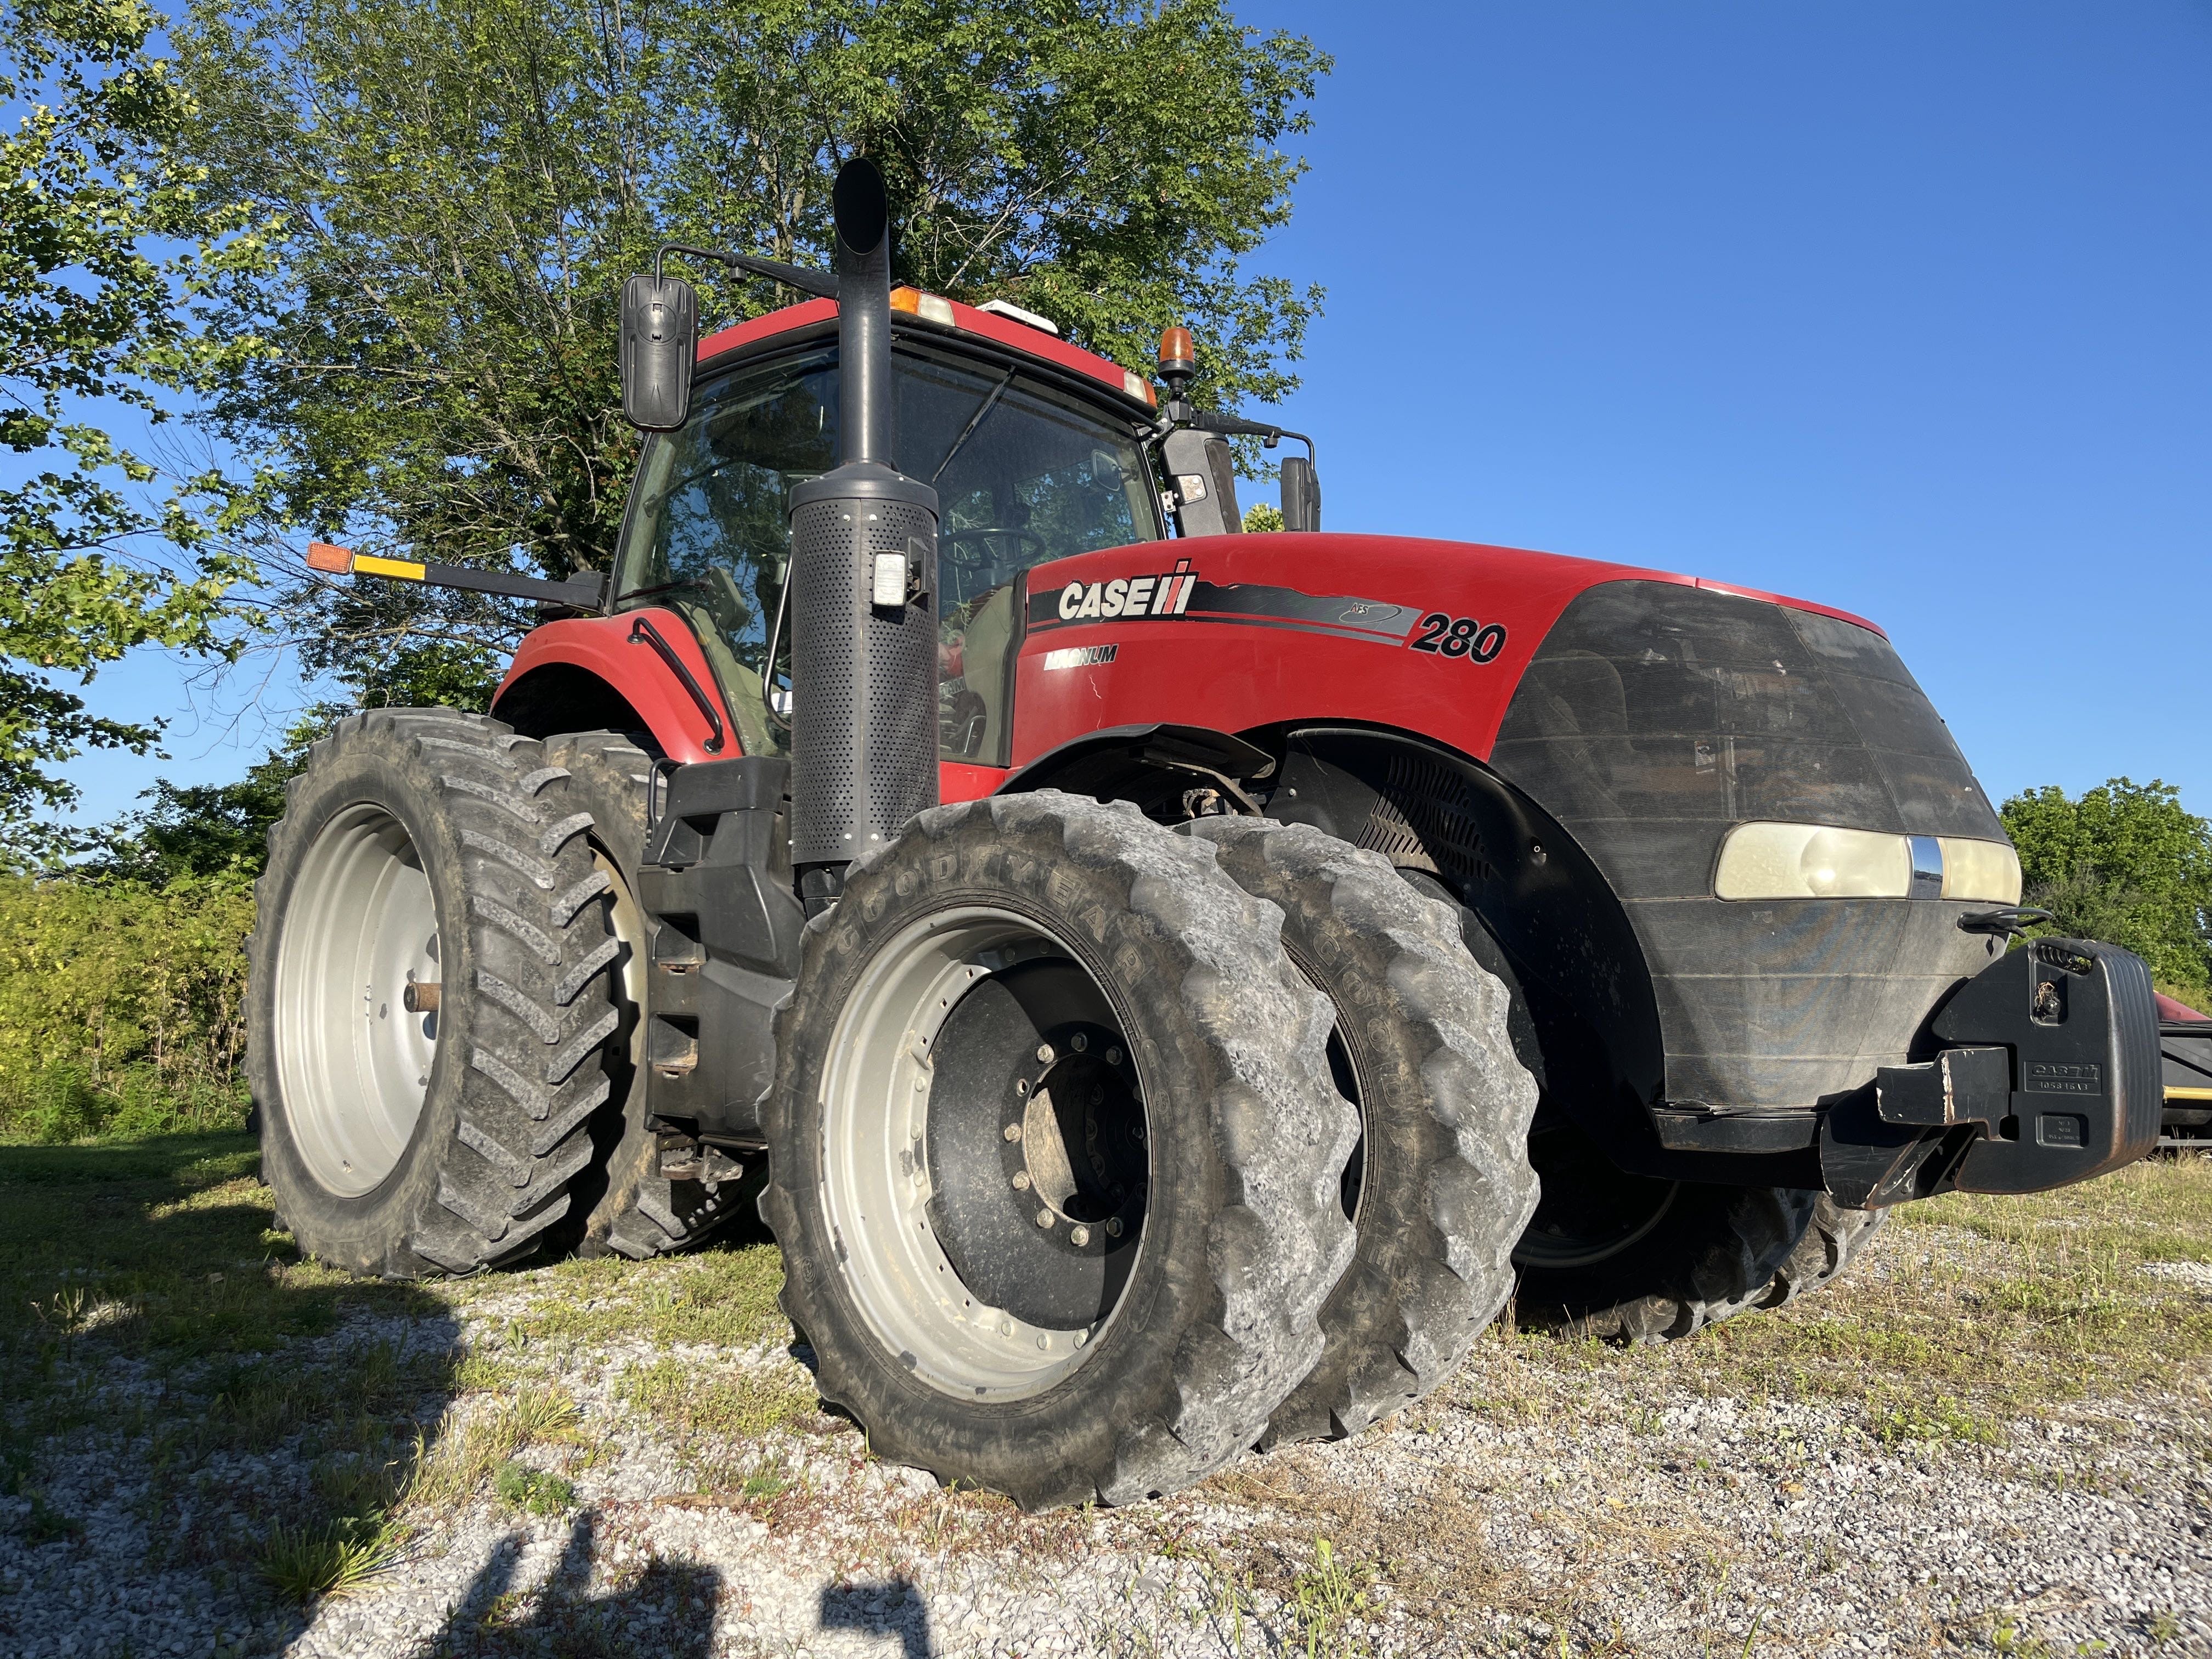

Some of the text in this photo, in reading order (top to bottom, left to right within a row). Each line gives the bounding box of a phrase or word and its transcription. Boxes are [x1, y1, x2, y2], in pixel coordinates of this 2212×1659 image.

[1350, 602, 1369, 615] AFS
[1408, 612, 1508, 665] 280
[837, 848, 1146, 985] GOODYEAR
